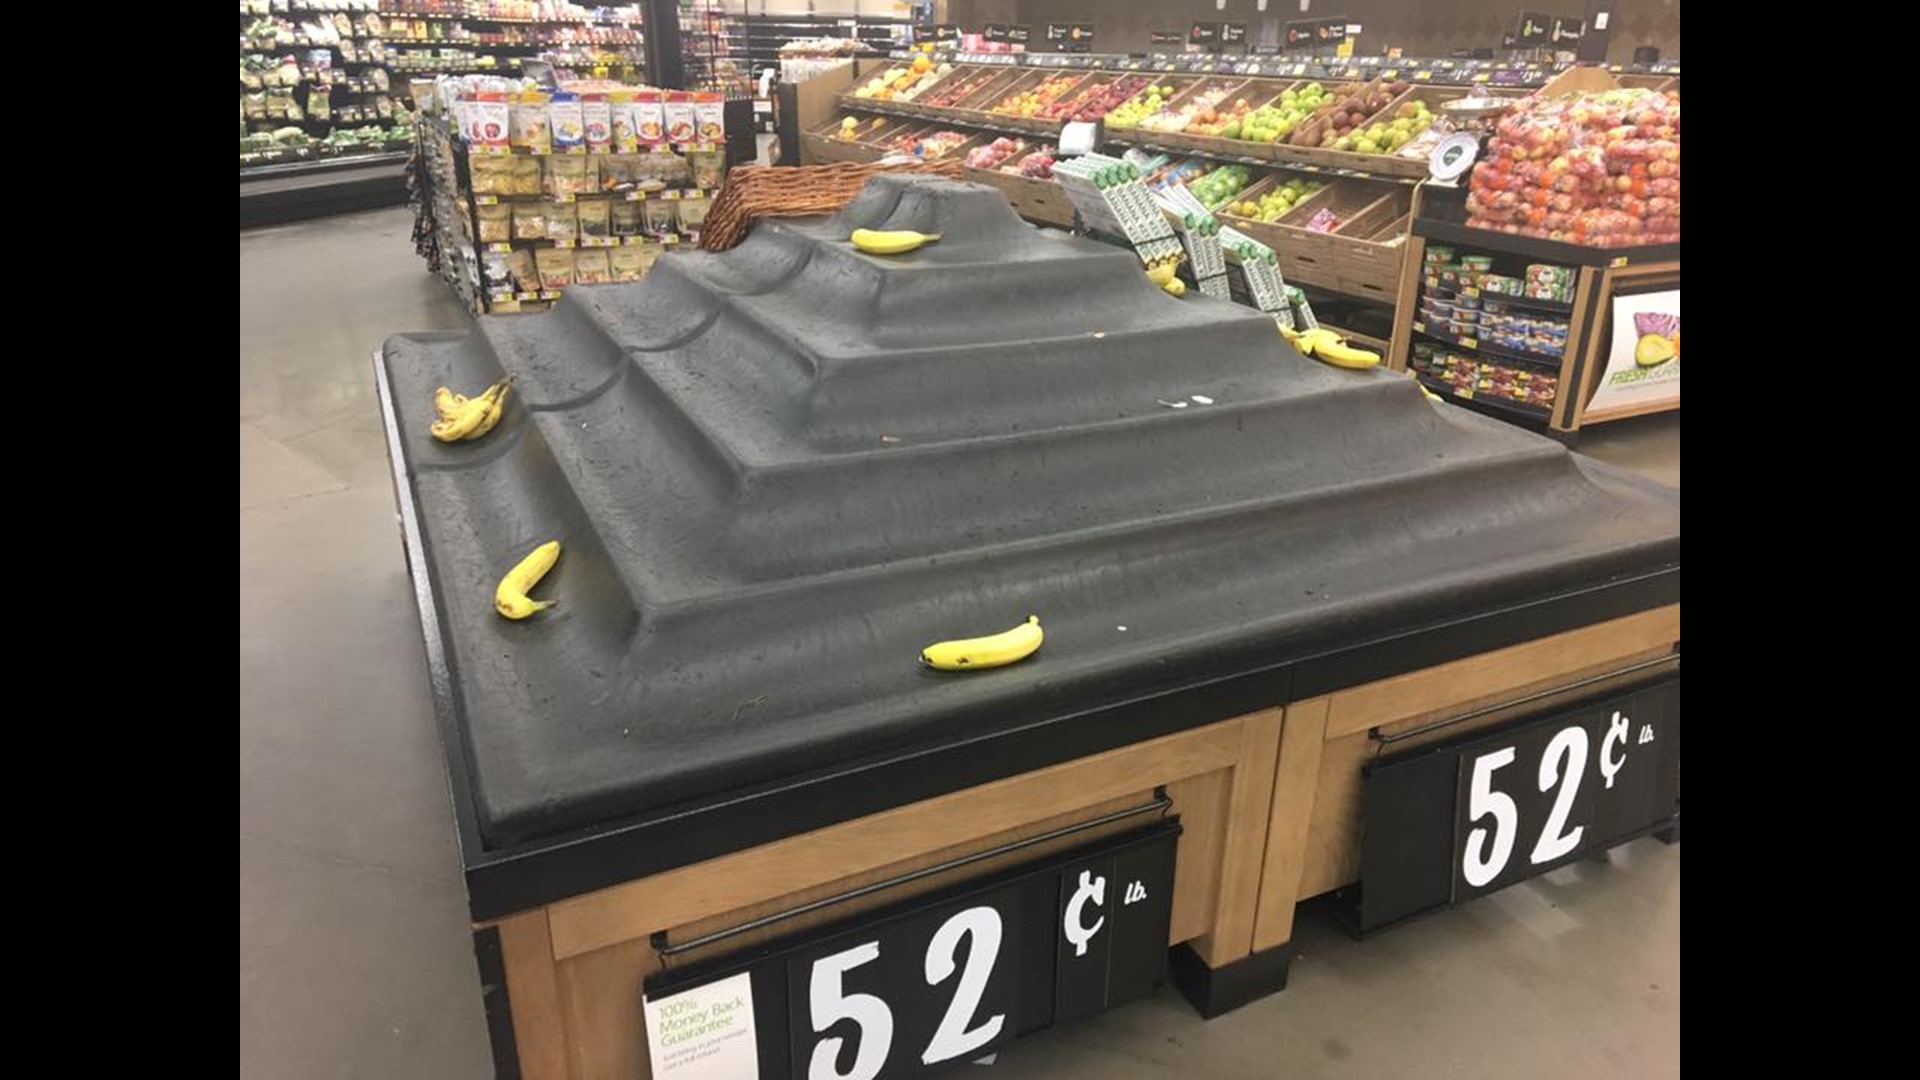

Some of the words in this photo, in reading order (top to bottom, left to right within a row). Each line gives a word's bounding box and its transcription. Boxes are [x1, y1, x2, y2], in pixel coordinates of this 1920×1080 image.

[1637, 724, 1655, 745] lb.
[1124, 880, 1148, 905] lb.
[659, 999, 697, 1020] 100%
[660, 1009, 708, 1034] Money
[712, 995, 744, 1017] Back
[661, 1016, 733, 1047] Guarantee
